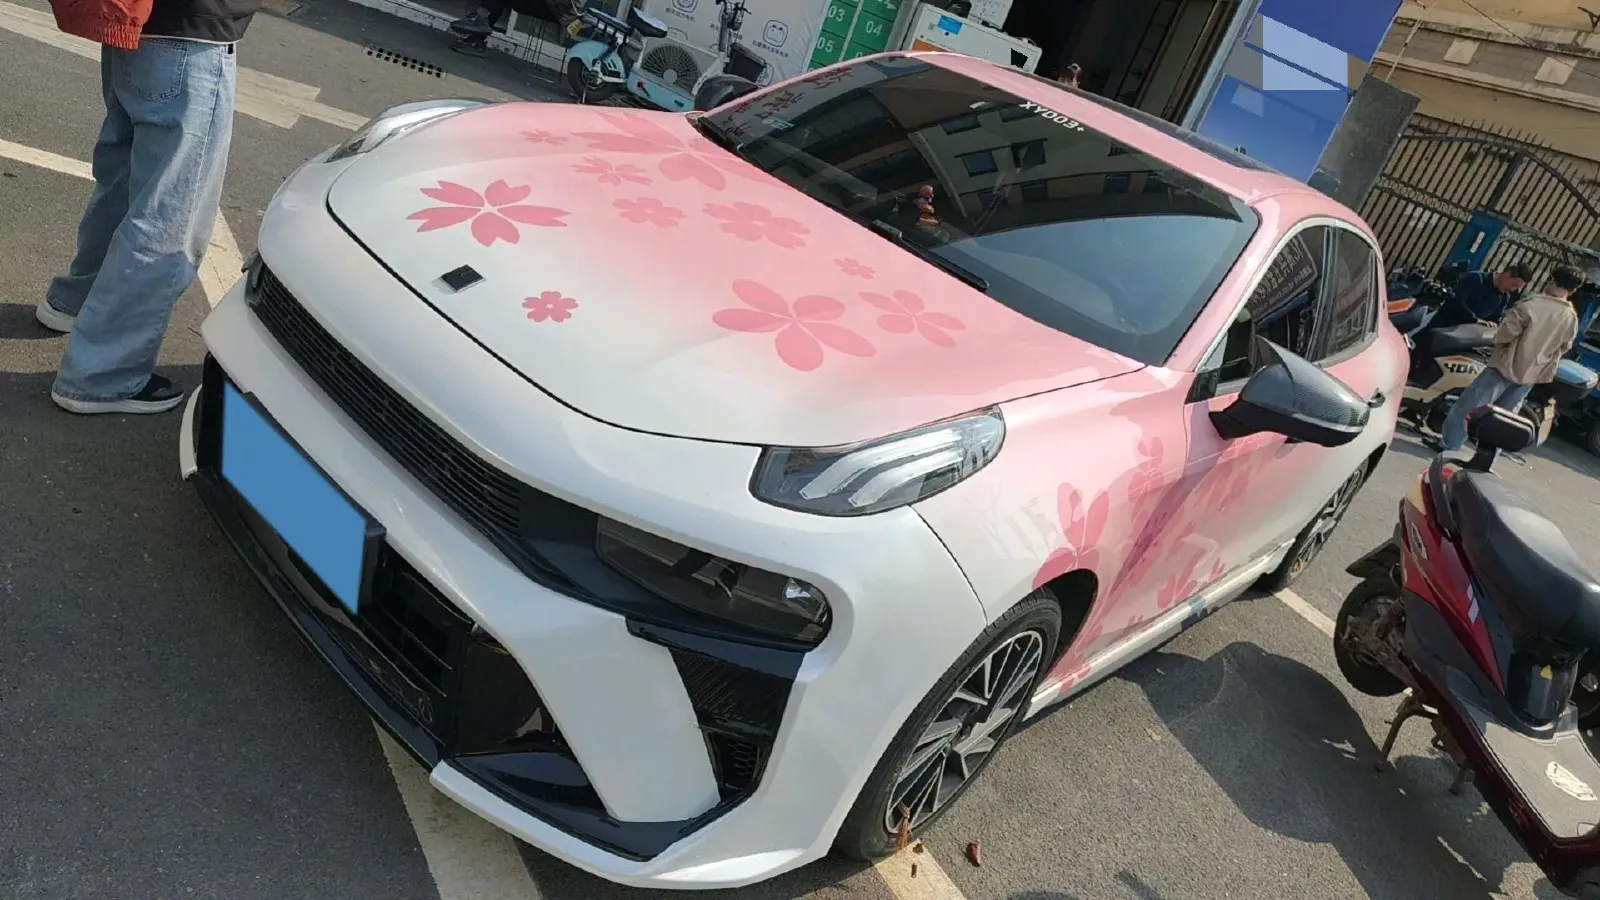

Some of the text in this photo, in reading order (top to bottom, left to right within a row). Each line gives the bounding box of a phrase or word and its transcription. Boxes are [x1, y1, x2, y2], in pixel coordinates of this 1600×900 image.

[828, 5, 846, 22] 03
[865, 21, 883, 37] 04
[817, 37, 834, 53] 05
